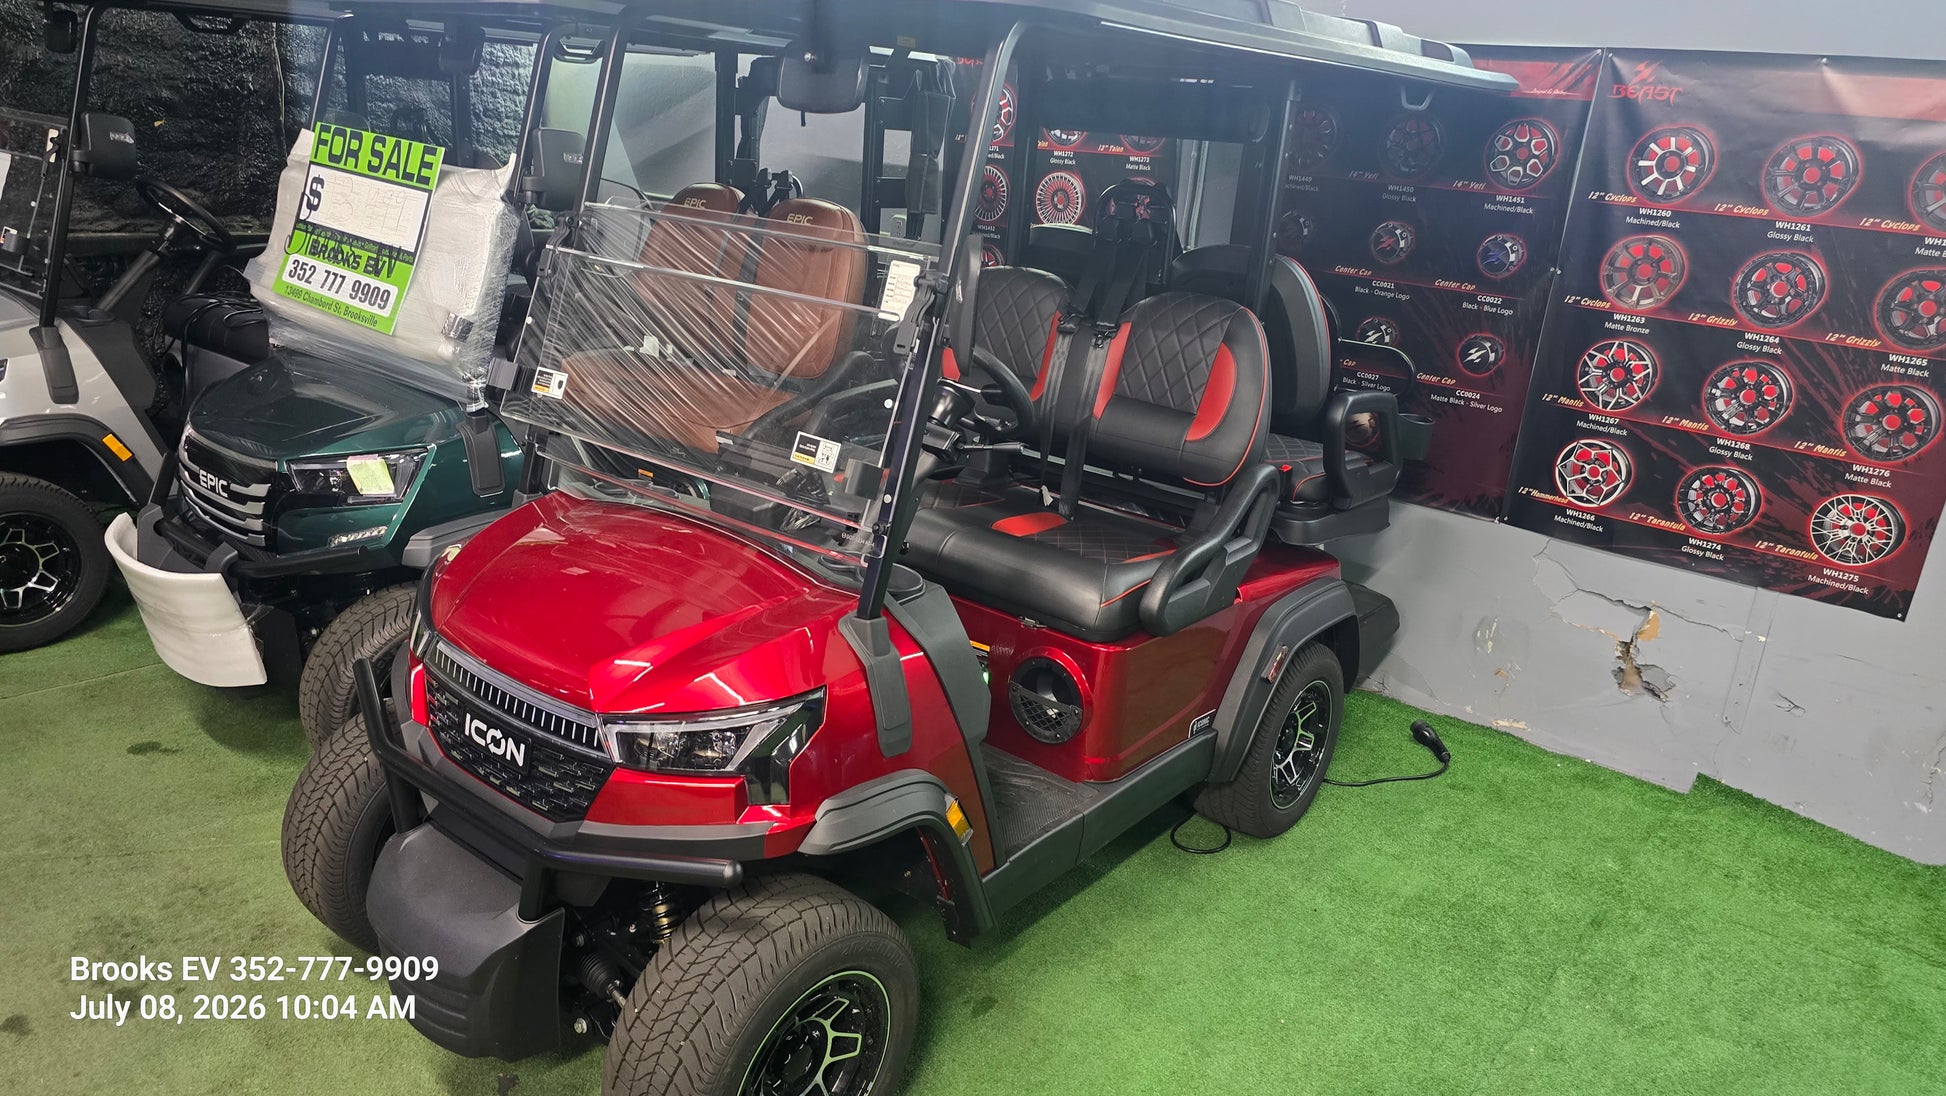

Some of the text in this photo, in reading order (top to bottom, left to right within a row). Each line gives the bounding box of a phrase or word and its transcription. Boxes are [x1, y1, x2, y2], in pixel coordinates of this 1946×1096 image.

[313, 123, 438, 186] FOR SALE
[1050, 158, 1064, 166] Glossy
[308, 174, 325, 212] $
[1401, 194, 1416, 202] Black
[1496, 194, 1525, 204] WH1451
[1605, 192, 1638, 204] Cyclops
[683, 197, 707, 210] EPIC
[1484, 202, 1534, 214] Machined/Black
[1714, 203, 1769, 216] 12" Cyclops
[786, 213, 813, 226] EPIC
[1639, 208, 1672, 218] WH1260
[1626, 216, 1680, 228] Machined/Black
[1775, 220, 1812, 232] WH1261
[1860, 217, 1920, 232] 12" Cyclops
[1767, 231, 1814, 243] Glossy Black
[1915, 247, 1940, 257] Matte
[1334, 265, 1372, 277] Center Cap
[288, 259, 391, 310] 352 777 9909
[1372, 280, 1395, 289] CC0021
[1434, 278, 1476, 292] Center Cap
[1354, 286, 1370, 295] Black
[1374, 288, 1392, 299] Orange
[1392, 291, 1410, 301] Logo
[1477, 295, 1502, 305] CC0022
[302, 292, 334, 310] Chambord
[343, 306, 378, 327] Brooksville
[1462, 301, 1478, 311] Black
[1483, 304, 1496, 314] Blue
[1496, 306, 1514, 317] Logo
[1581, 298, 1612, 309] Cyclops
[1613, 314, 1646, 324] WH1263
[1688, 312, 1738, 328] 12" Grizzly
[1604, 322, 1650, 335] Matte Bronze
[1744, 332, 1780, 344] WH1264
[1825, 332, 1882, 348] 12" Grizzly
[1736, 342, 1783, 355] Glossy Black
[1343, 358, 1357, 367] Cap
[1888, 354, 1928, 366] WH1265
[1356, 372, 1380, 382] CC0027
[1881, 364, 1930, 378] Matte Black
[1342, 377, 1358, 386] Black
[1361, 380, 1376, 390] Silver
[1376, 383, 1391, 392] Logo
[1416, 372, 1456, 386] Center Cap
[1456, 390, 1481, 400] CC0024
[1430, 394, 1448, 404] Matte
[1449, 396, 1465, 406] Black
[1470, 400, 1486, 410] Silver
[1486, 403, 1503, 414] Logo
[1558, 396, 1585, 408] Mantis
[1588, 414, 1620, 425] WH1267
[1662, 416, 1710, 432] 12" Mantis
[1576, 420, 1628, 436] Machined/Black
[1716, 438, 1750, 450] WH1268
[1794, 440, 1848, 458] 12" Mantis
[1709, 446, 1753, 461] Glossy Black
[1852, 464, 1891, 478] WH1276
[199, 469, 230, 498] EPIC
[1844, 472, 1892, 488] Matte Black
[1566, 508, 1596, 522] WH1266
[1554, 515, 1604, 533] Machined/Black
[1629, 512, 1686, 532] 12" Tarantula
[1688, 537, 1722, 550] WH1274
[1755, 540, 1818, 560] 12" Tarantula
[1681, 545, 1725, 561] Glossy Black
[1823, 568, 1859, 582] WH1275
[1808, 574, 1869, 595] Machined/Black
[464, 712, 526, 767] ICON
